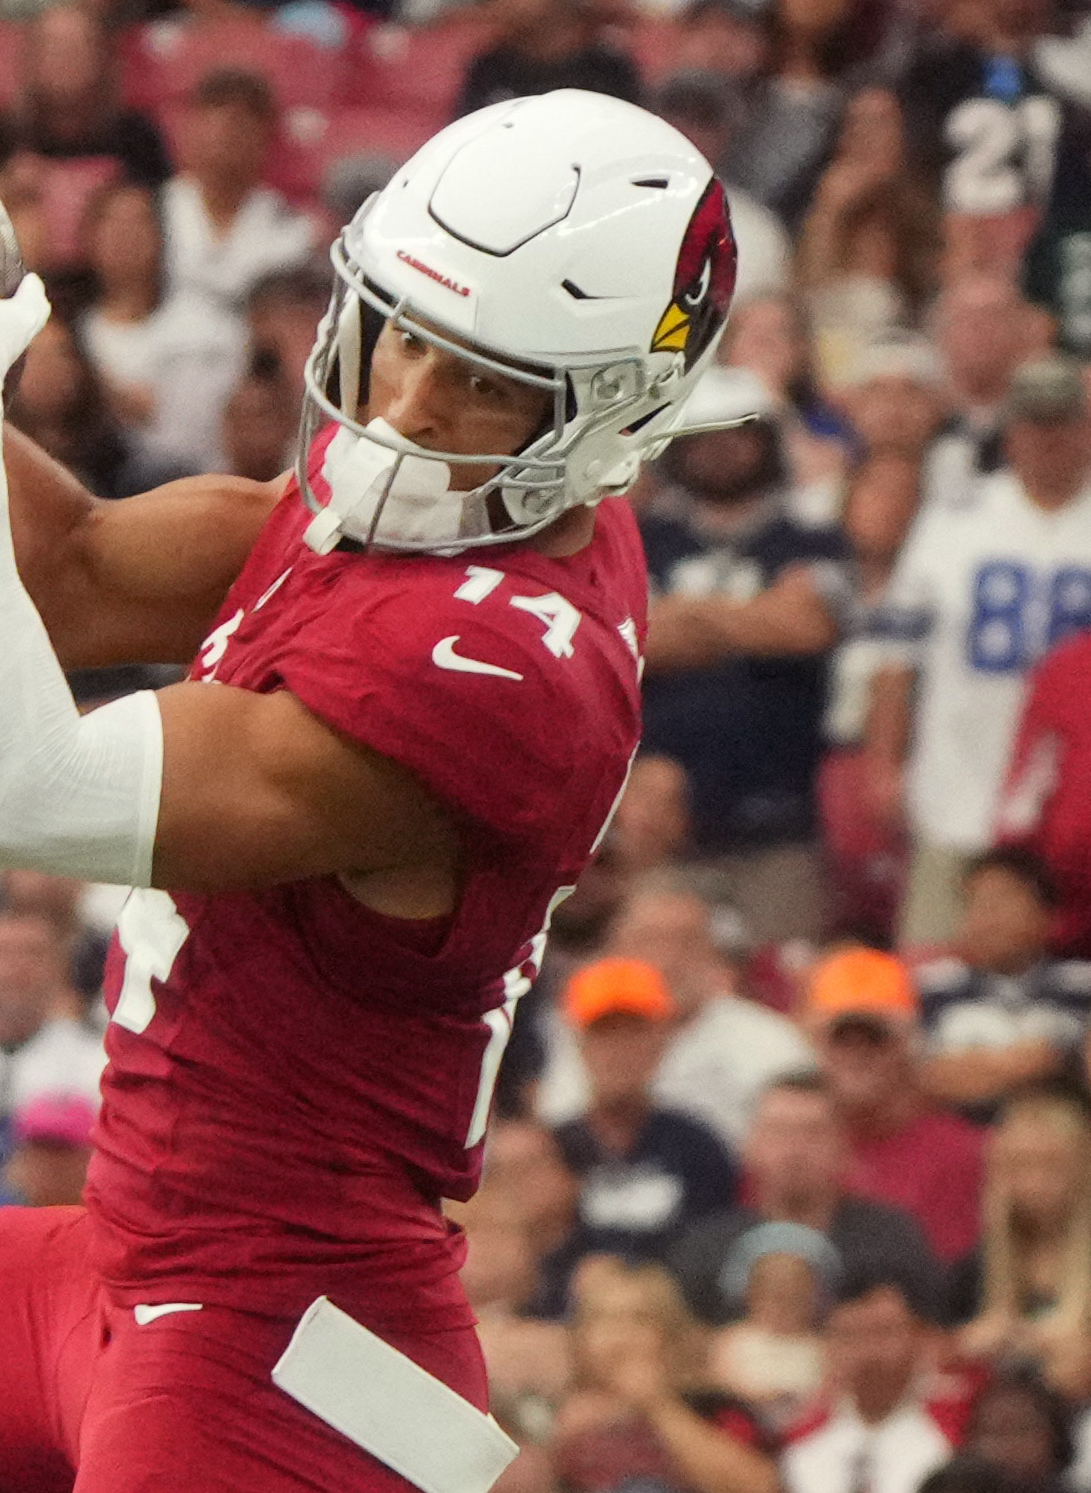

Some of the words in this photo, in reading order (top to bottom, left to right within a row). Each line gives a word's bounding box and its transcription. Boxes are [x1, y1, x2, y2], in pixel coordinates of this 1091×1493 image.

[943, 97, 1062, 214] 21
[396, 249, 470, 297] CARDINALS
[453, 564, 582, 659] 14
